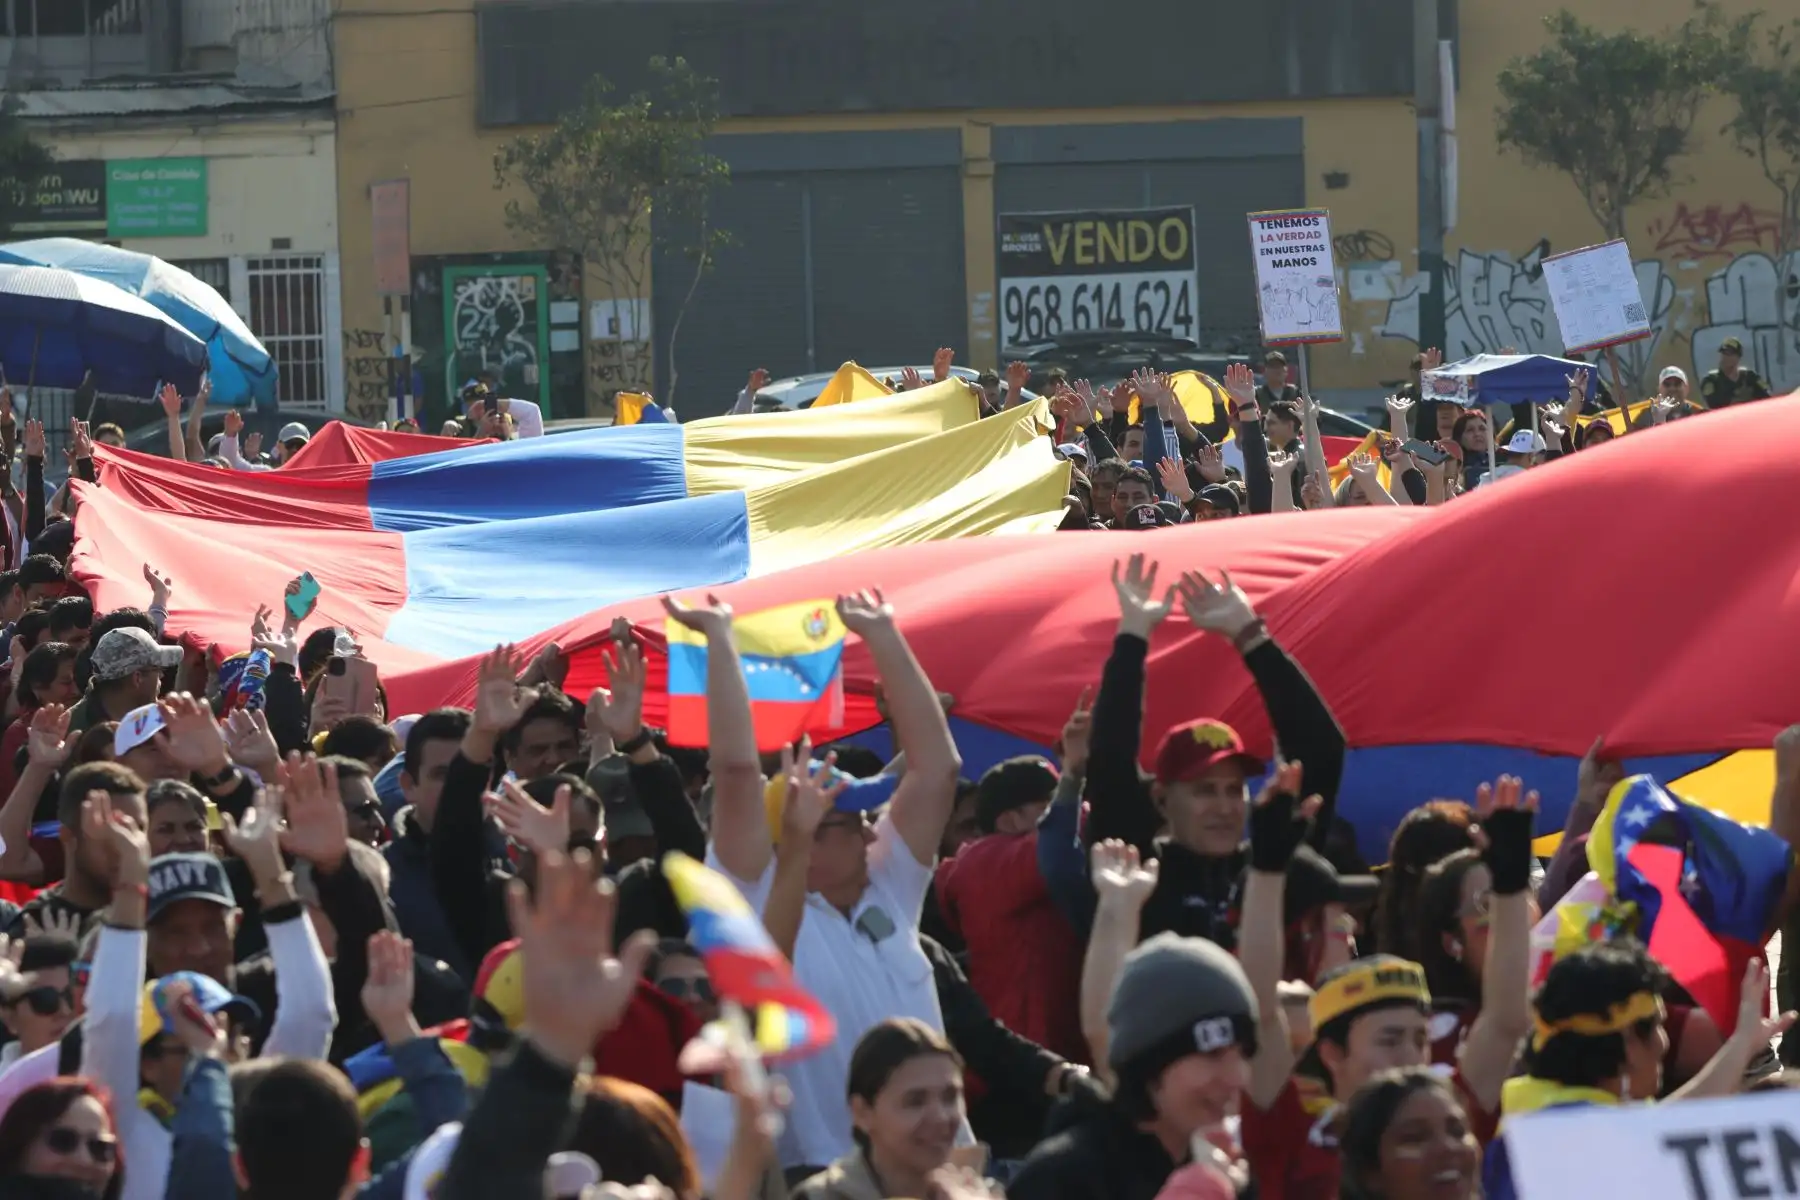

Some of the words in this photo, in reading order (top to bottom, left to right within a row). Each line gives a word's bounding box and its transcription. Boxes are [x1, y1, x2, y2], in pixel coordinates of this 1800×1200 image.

[1259, 217, 1320, 230] TENEMOS
[1043, 217, 1188, 266] VENDO
[1260, 234, 1276, 243] LA
[1276, 231, 1322, 242] VERDAD
[1260, 247, 1274, 256] EN
[1275, 244, 1325, 255] NUESTRAS
[1272, 257, 1318, 269] MANOS
[1005, 285, 1063, 346] 968
[1073, 281, 1126, 332] 614
[1134, 279, 1193, 337] 624
[149, 862, 208, 898] NAVY
